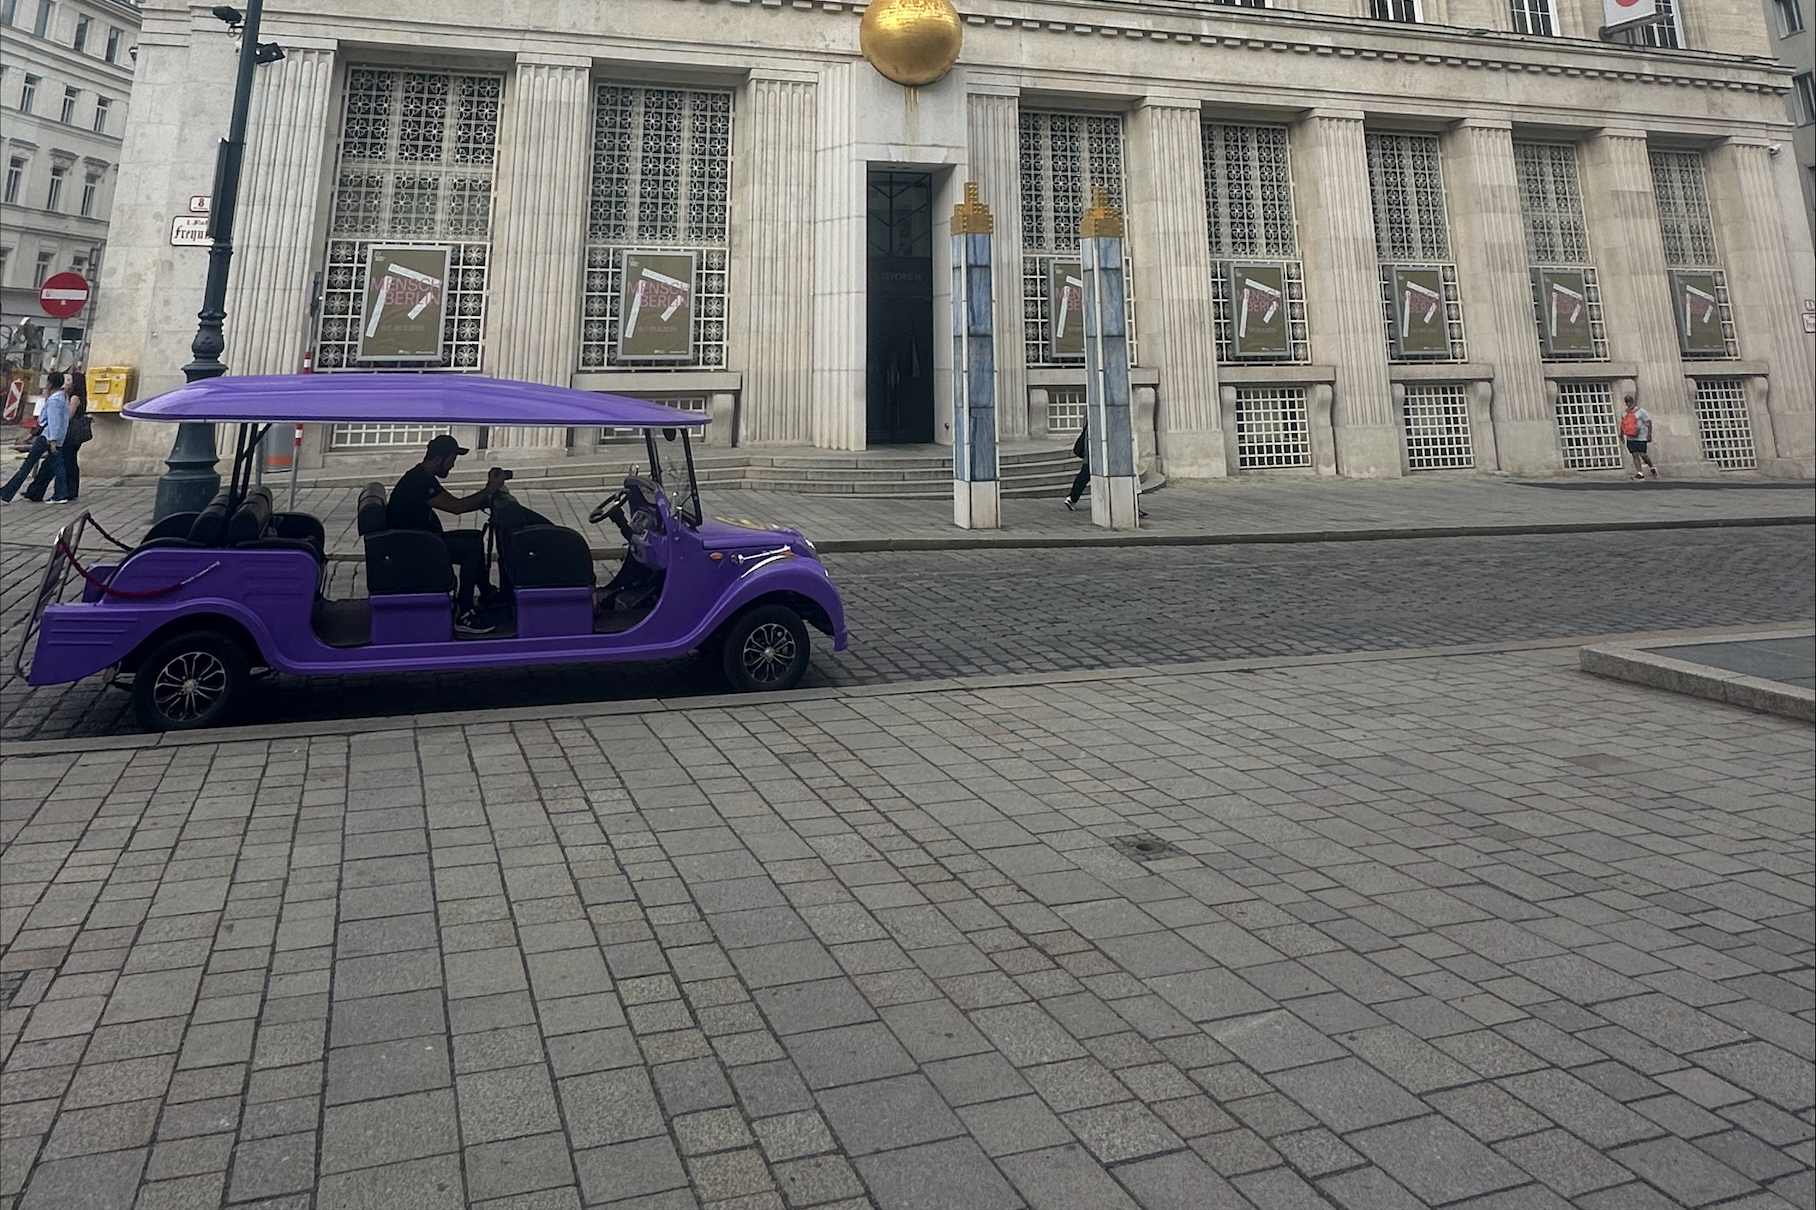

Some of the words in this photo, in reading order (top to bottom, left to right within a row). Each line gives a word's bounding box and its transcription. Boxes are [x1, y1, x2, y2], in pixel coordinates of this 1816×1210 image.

[198, 197, 205, 208] 8
[174, 225, 210, 242] Freyu
[370, 276, 442, 291] MENSCH
[385, 291, 441, 306] BERLIN
